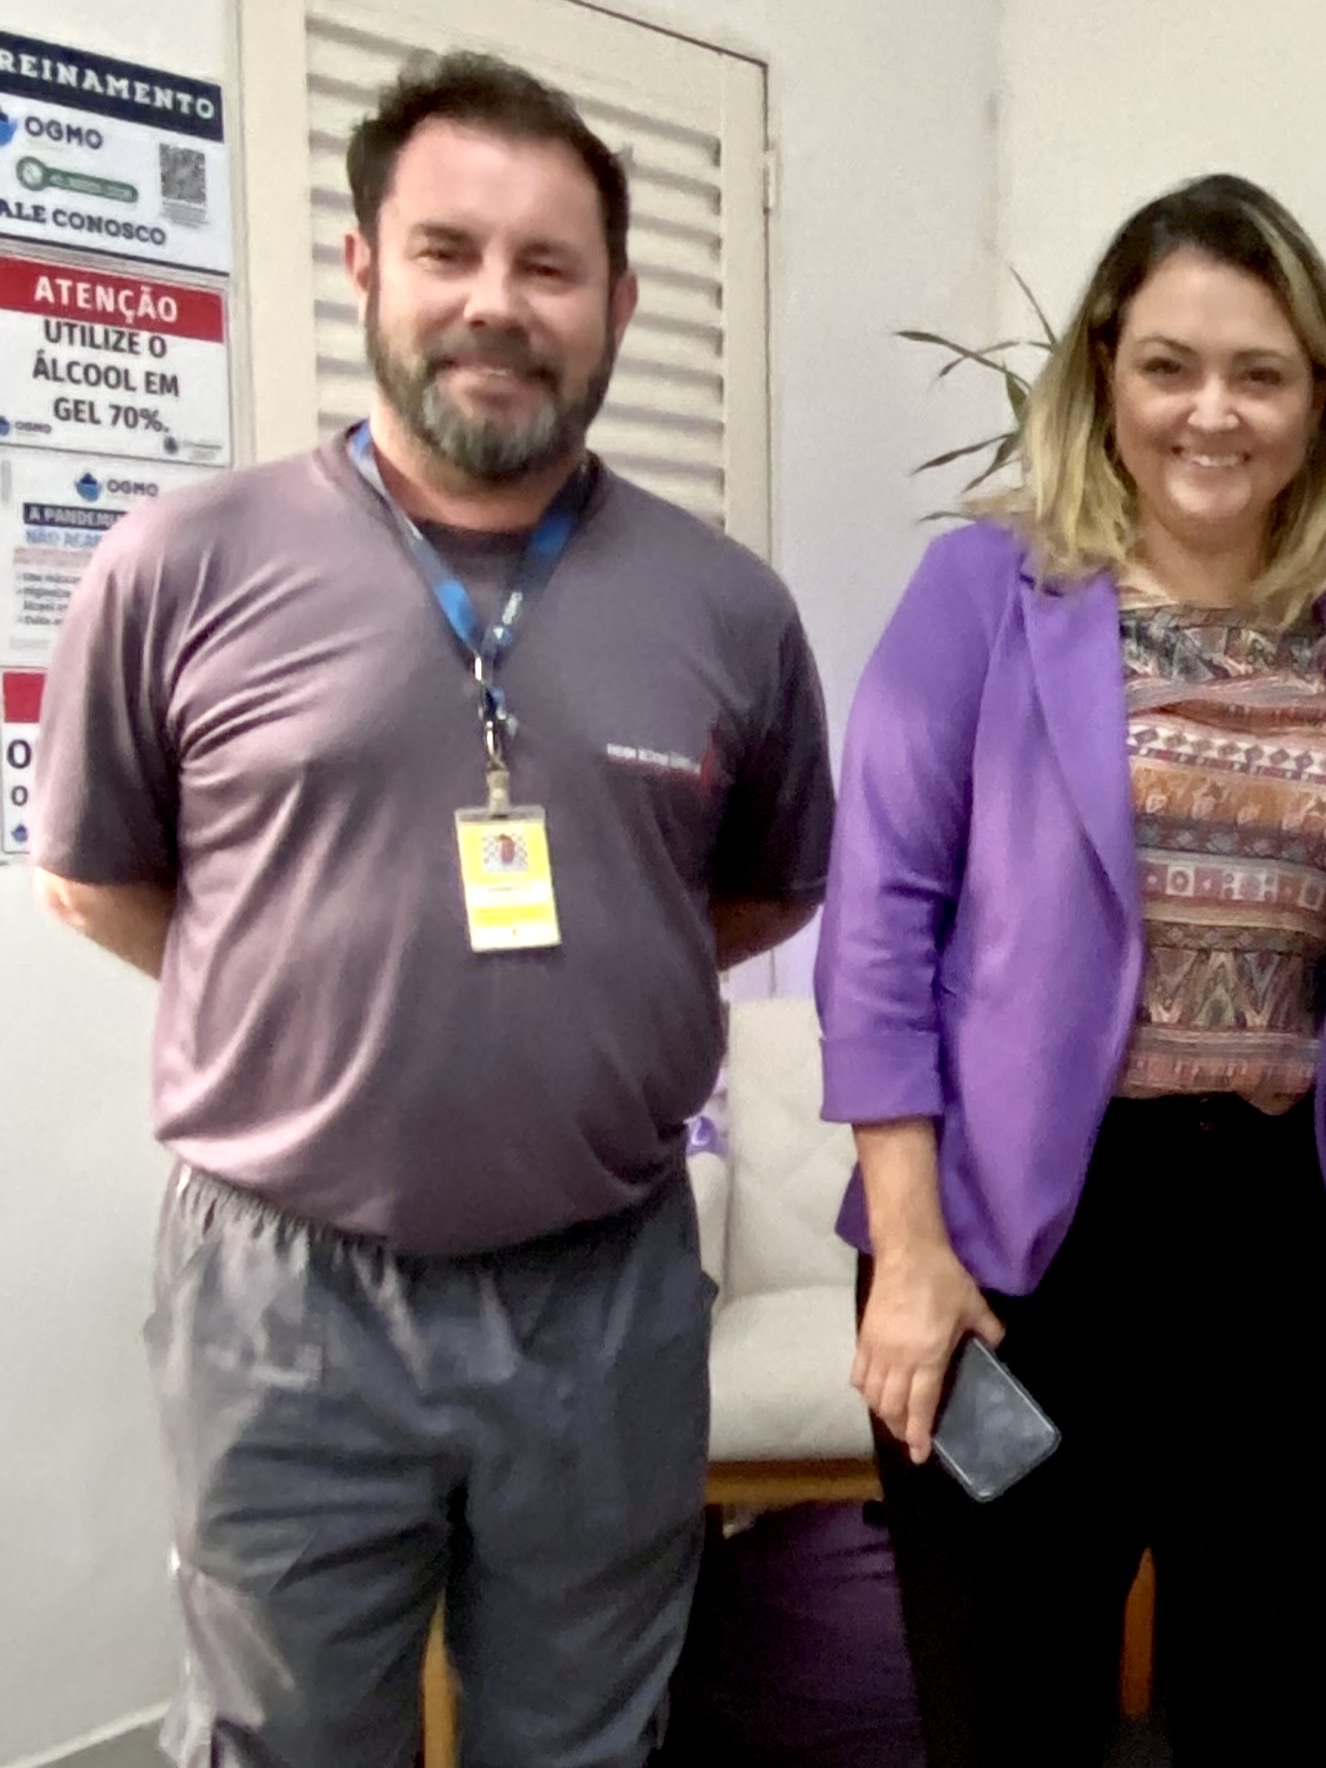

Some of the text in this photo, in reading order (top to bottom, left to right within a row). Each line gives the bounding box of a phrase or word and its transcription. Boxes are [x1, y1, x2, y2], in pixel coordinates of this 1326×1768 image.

[24, 116, 104, 150] OGMO
[52, 208, 167, 246] CONOSCO
[34, 275, 178, 324] ATENÇÃO
[44, 318, 167, 359] UTILIZE O
[32, 348, 180, 397] ÁLCOOL EM
[53, 397, 170, 433] GEL 70%.
